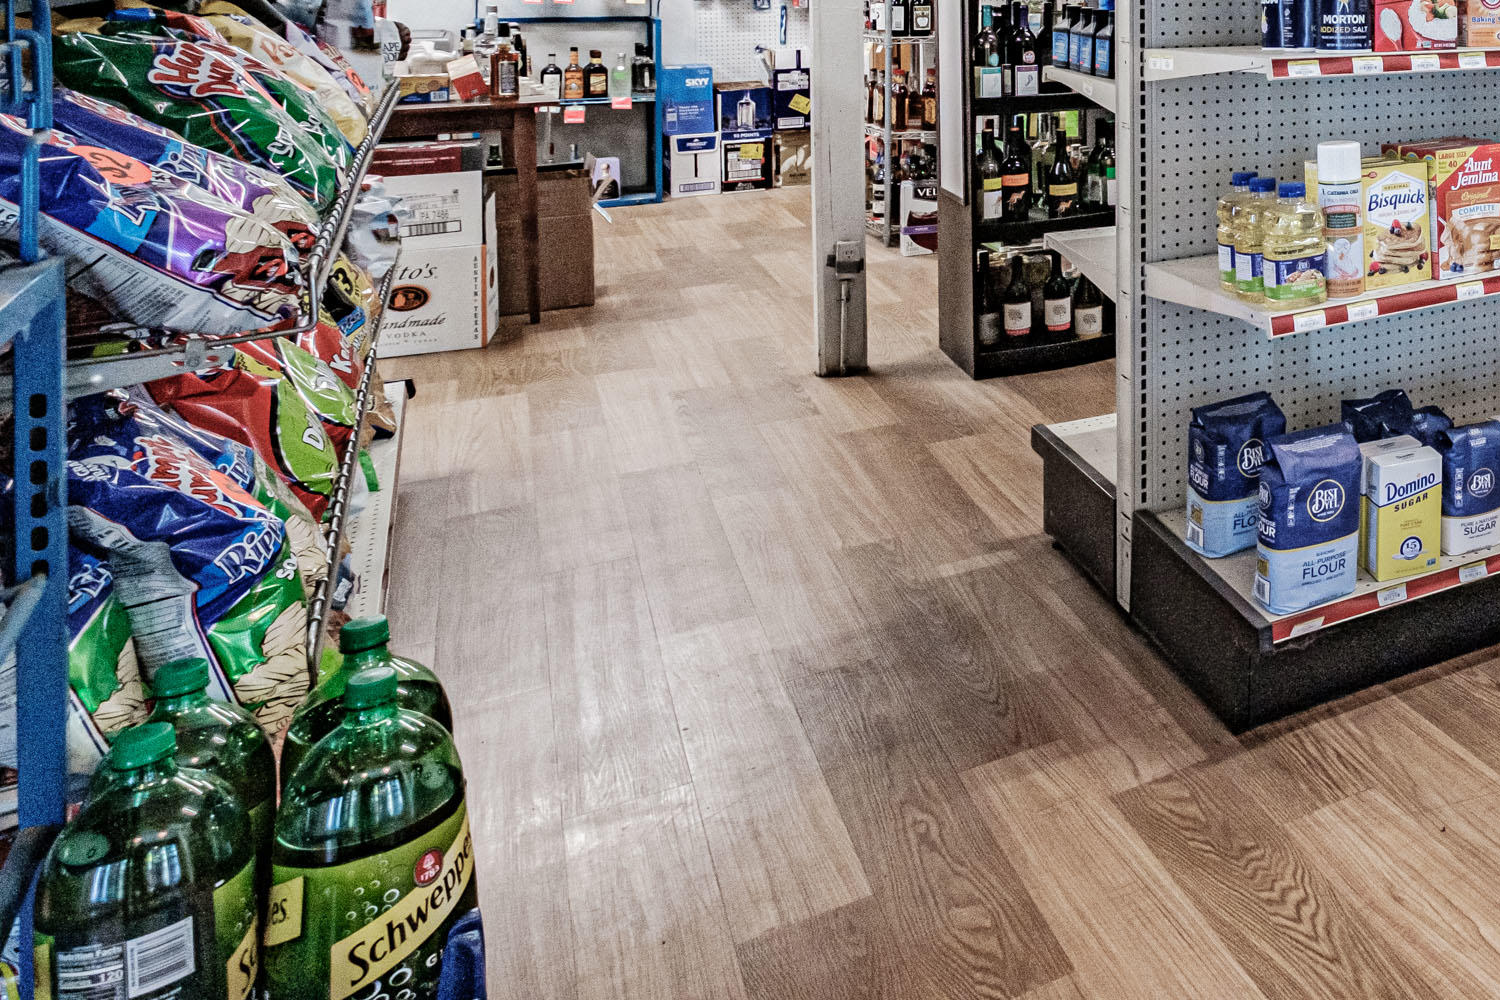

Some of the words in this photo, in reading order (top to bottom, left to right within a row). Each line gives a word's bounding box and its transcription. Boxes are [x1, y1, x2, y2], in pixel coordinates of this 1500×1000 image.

[1322, 14, 1366, 24] MORTON
[1472, 16, 1496, 24] Baking
[685, 78, 710, 87] SKYY
[1465, 157, 1493, 173] Aunt
[1451, 172, 1499, 190] Jemima
[1368, 189, 1426, 211] Bisquick
[1461, 187, 1492, 201] Original
[1458, 204, 1495, 216] COMPLETE
[1385, 473, 1436, 502] Domino
[1312, 487, 1338, 512] BEST
[1394, 493, 1429, 513] SUGAR
[1463, 520, 1497, 536] SUGAR
[1406, 541, 1417, 550] 15
[1302, 551, 1346, 568] ALL-PURPOSE
[1302, 558, 1346, 580] FLOUR
